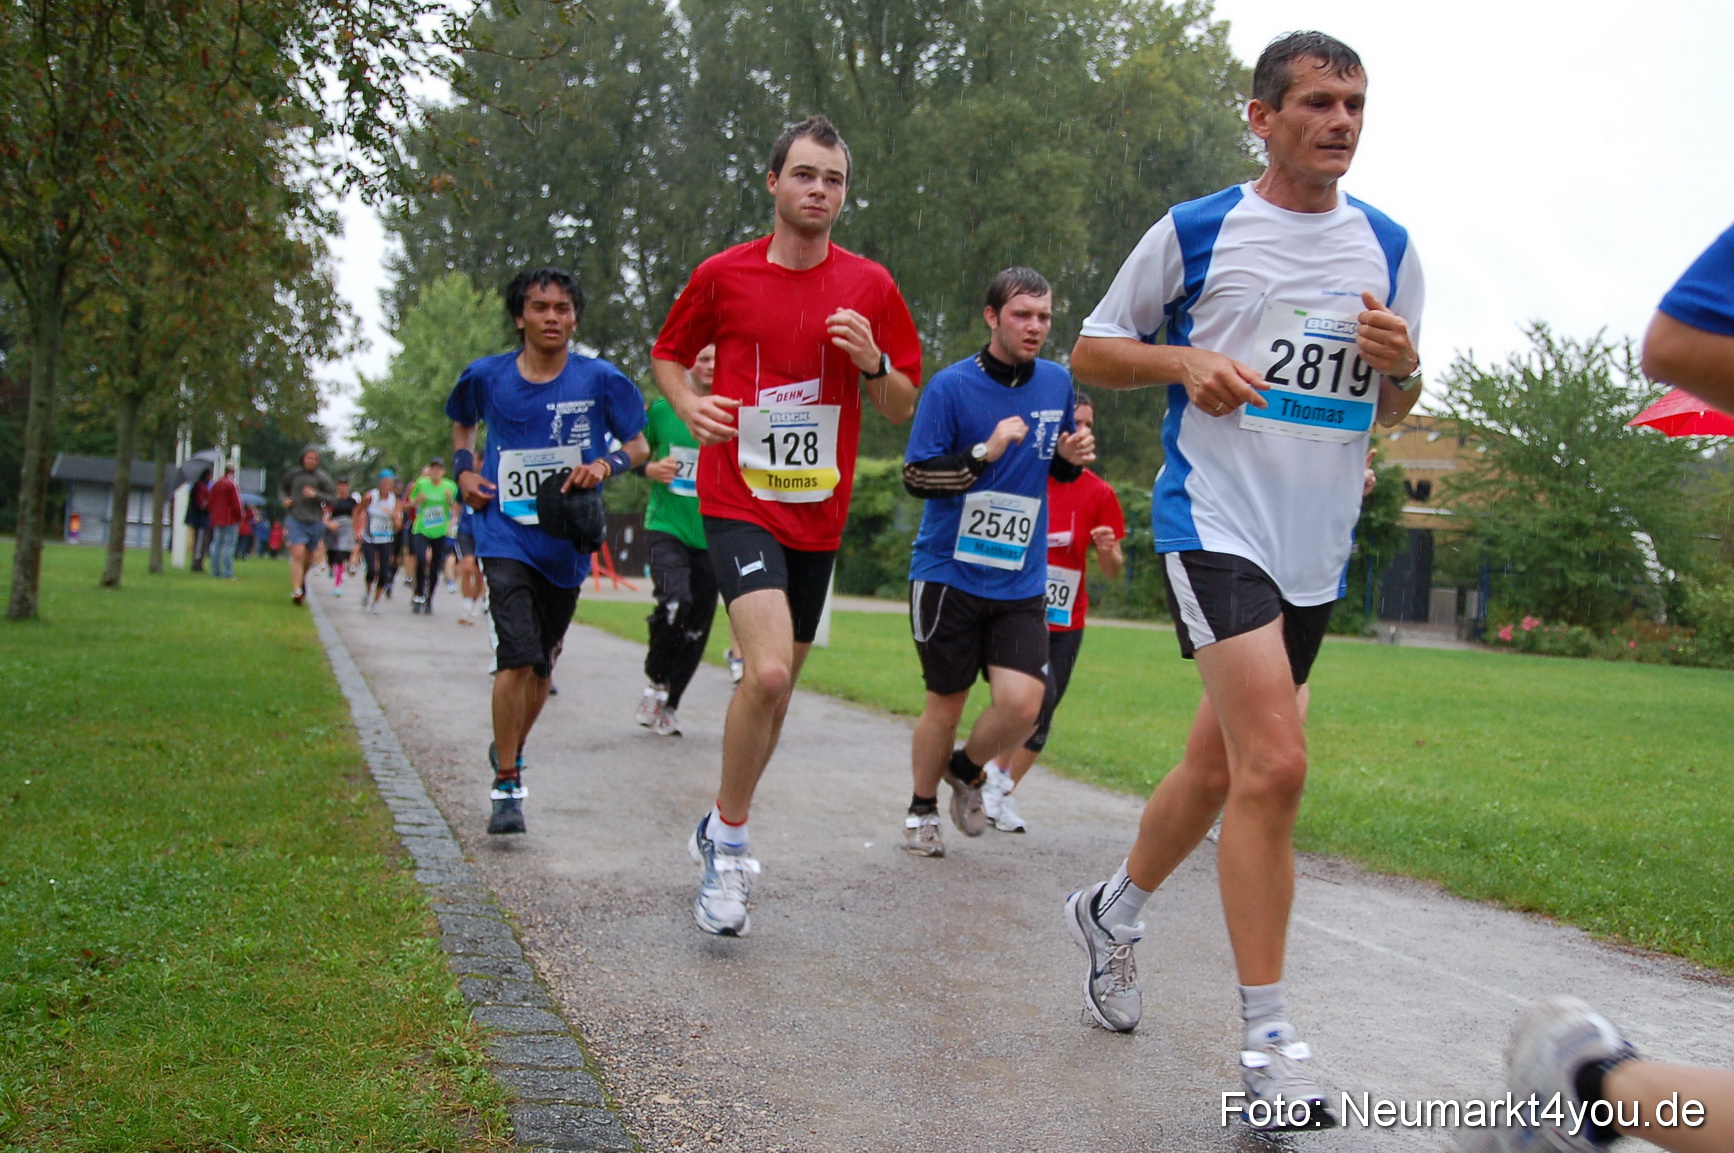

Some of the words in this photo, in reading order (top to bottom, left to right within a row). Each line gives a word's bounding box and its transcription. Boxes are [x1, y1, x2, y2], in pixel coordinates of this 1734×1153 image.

[1264, 338, 1372, 398] 2819
[776, 389, 803, 403] DEHN
[1281, 398, 1345, 424] Thomas
[761, 431, 818, 466] 128
[766, 474, 818, 489] Thomas
[968, 509, 1031, 543] 2549
